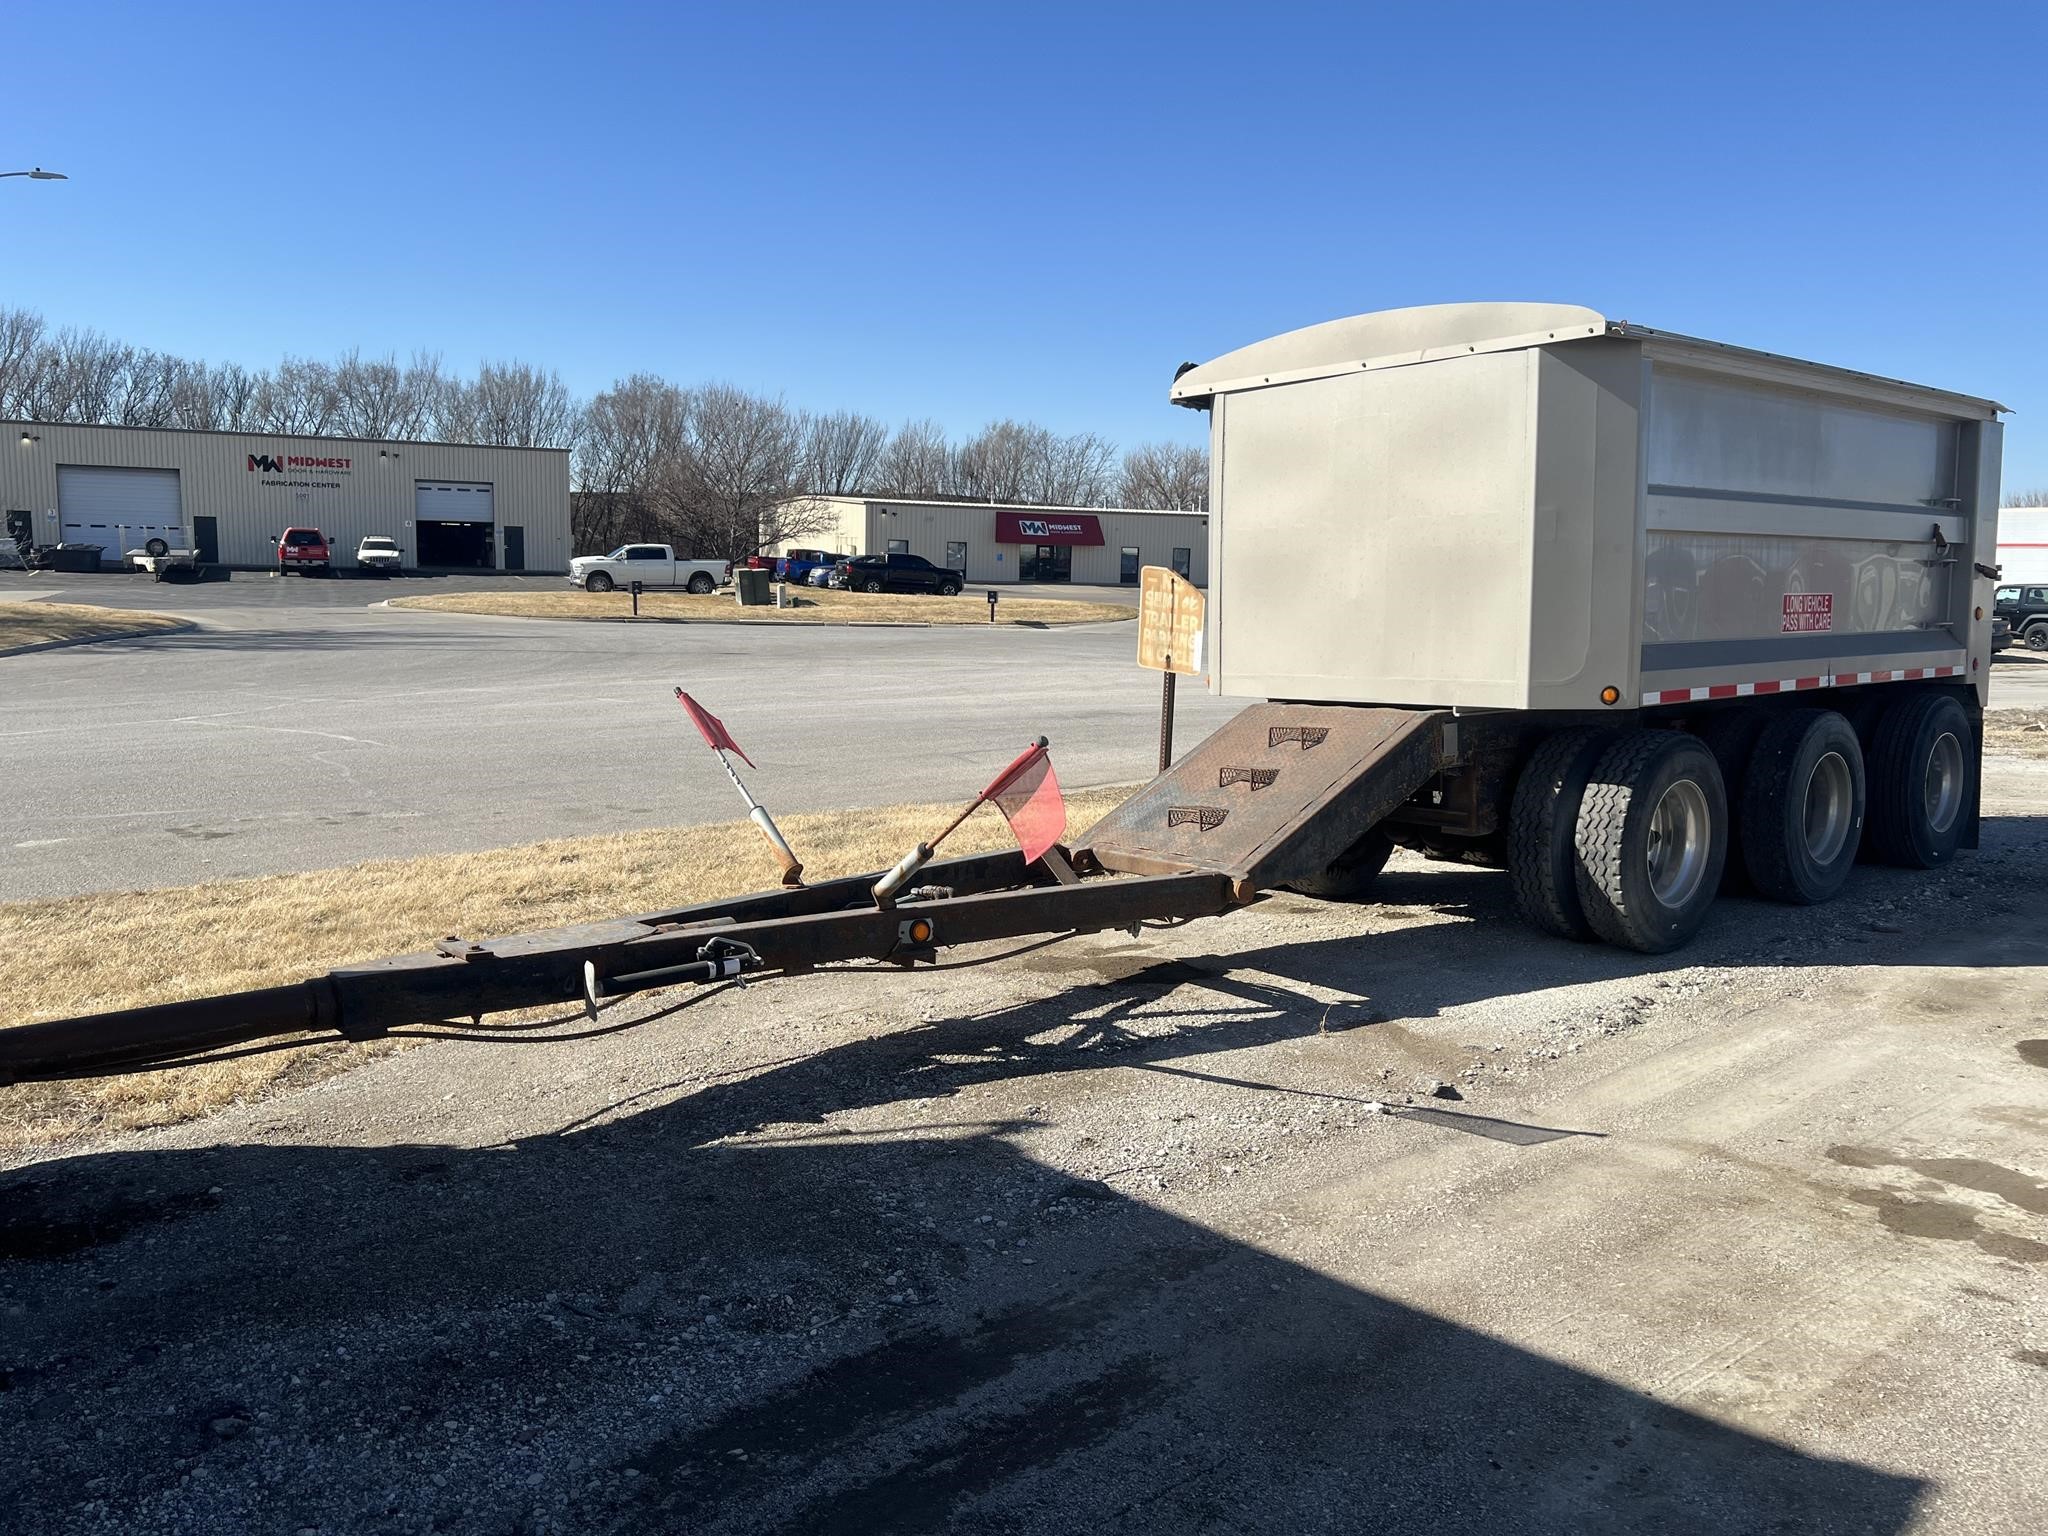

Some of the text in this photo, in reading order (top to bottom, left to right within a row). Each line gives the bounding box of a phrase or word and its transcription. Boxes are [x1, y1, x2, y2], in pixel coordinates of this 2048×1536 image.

[287, 456, 352, 469] MIDWEST
[261, 480, 310, 488] FABRICATION
[1145, 590, 1179, 610] SEMI
[1786, 596, 1829, 612] LONG VEHICLE
[1144, 609, 1199, 631] TRAILER
[1782, 613, 1831, 631] PASS WITH CARE
[1143, 627, 1196, 650] PARKING
